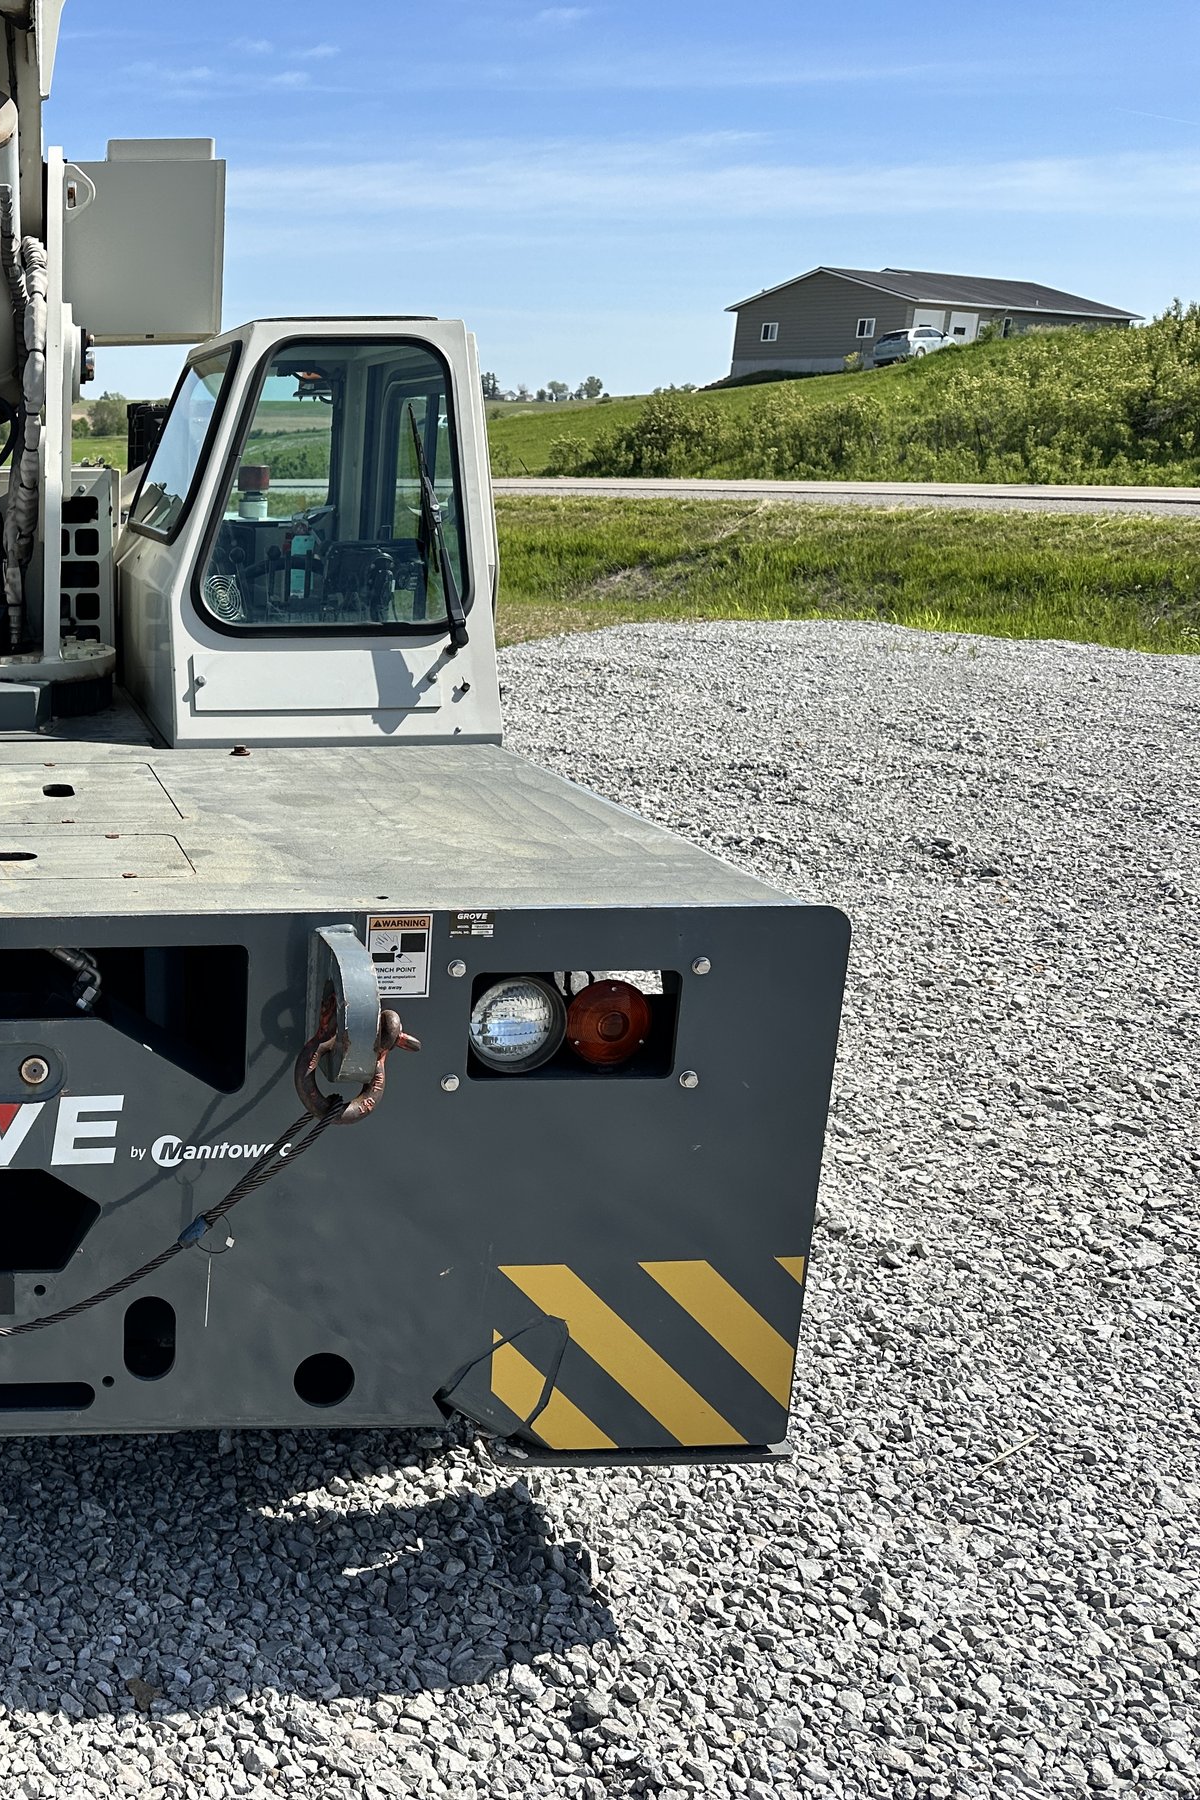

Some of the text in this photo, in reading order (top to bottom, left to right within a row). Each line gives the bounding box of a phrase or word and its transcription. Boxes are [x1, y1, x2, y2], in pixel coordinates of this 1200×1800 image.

[457, 912, 488, 920] GROVE
[382, 919, 426, 927] WARNING
[130, 1145, 147, 1161] by
